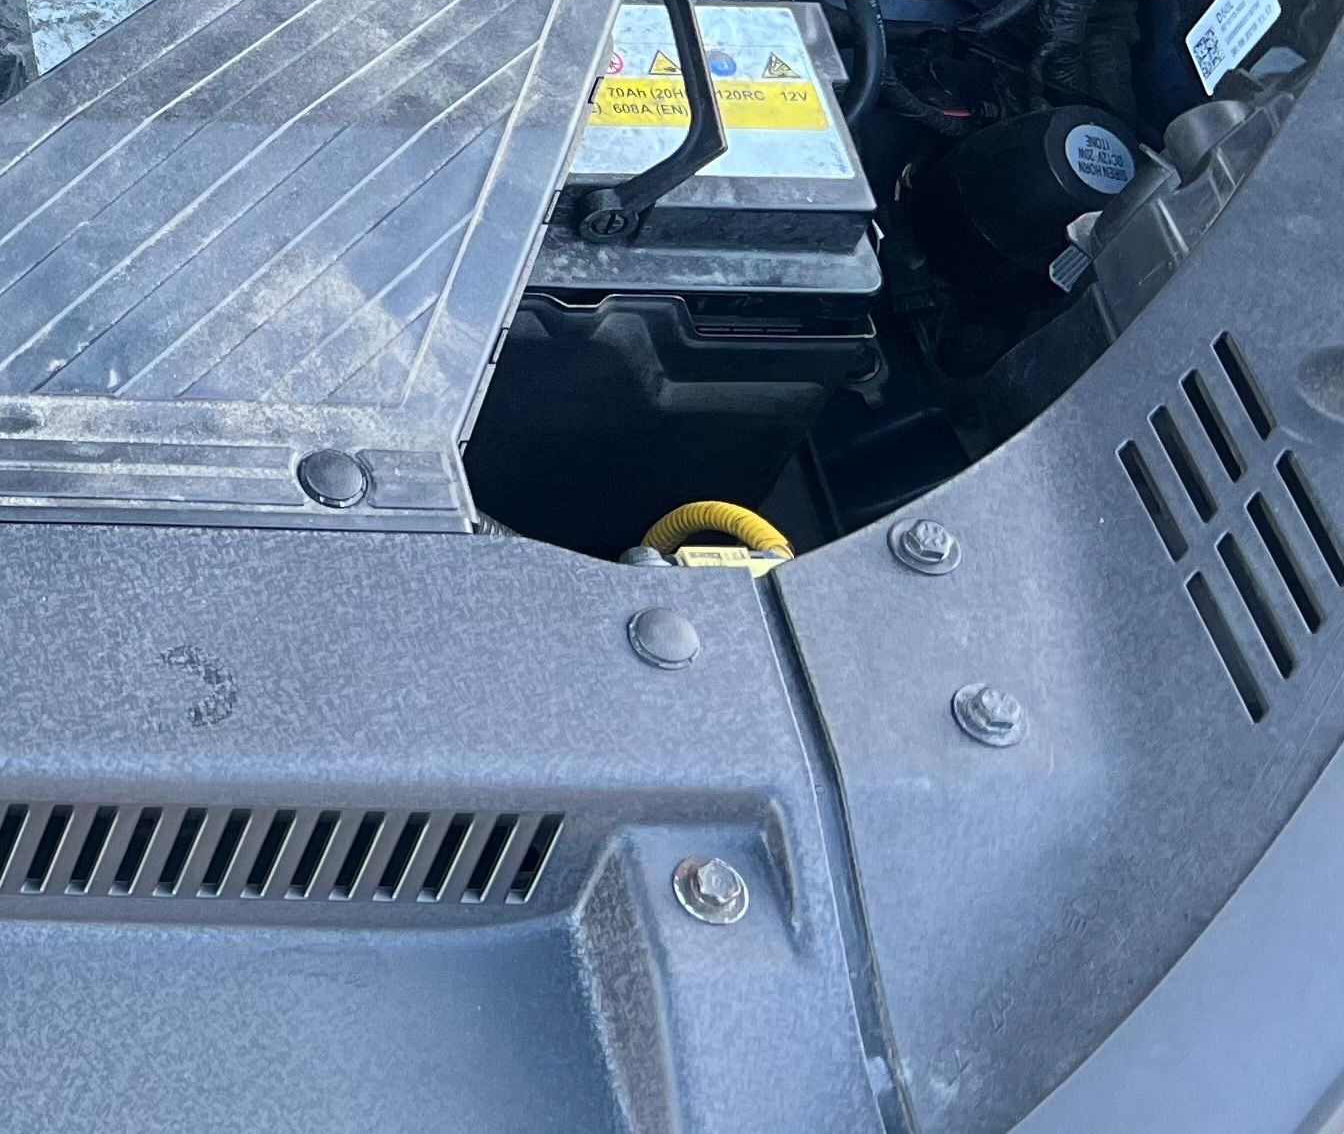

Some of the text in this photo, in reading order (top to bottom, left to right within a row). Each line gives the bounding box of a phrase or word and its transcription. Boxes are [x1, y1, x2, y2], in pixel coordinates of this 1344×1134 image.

[606, 87, 647, 99] 70Ah
[650, 87, 686, 101] (20H
[779, 91, 808, 102] 12V
[612, 103, 651, 115] 608A
[655, 103, 689, 117] (EN)
